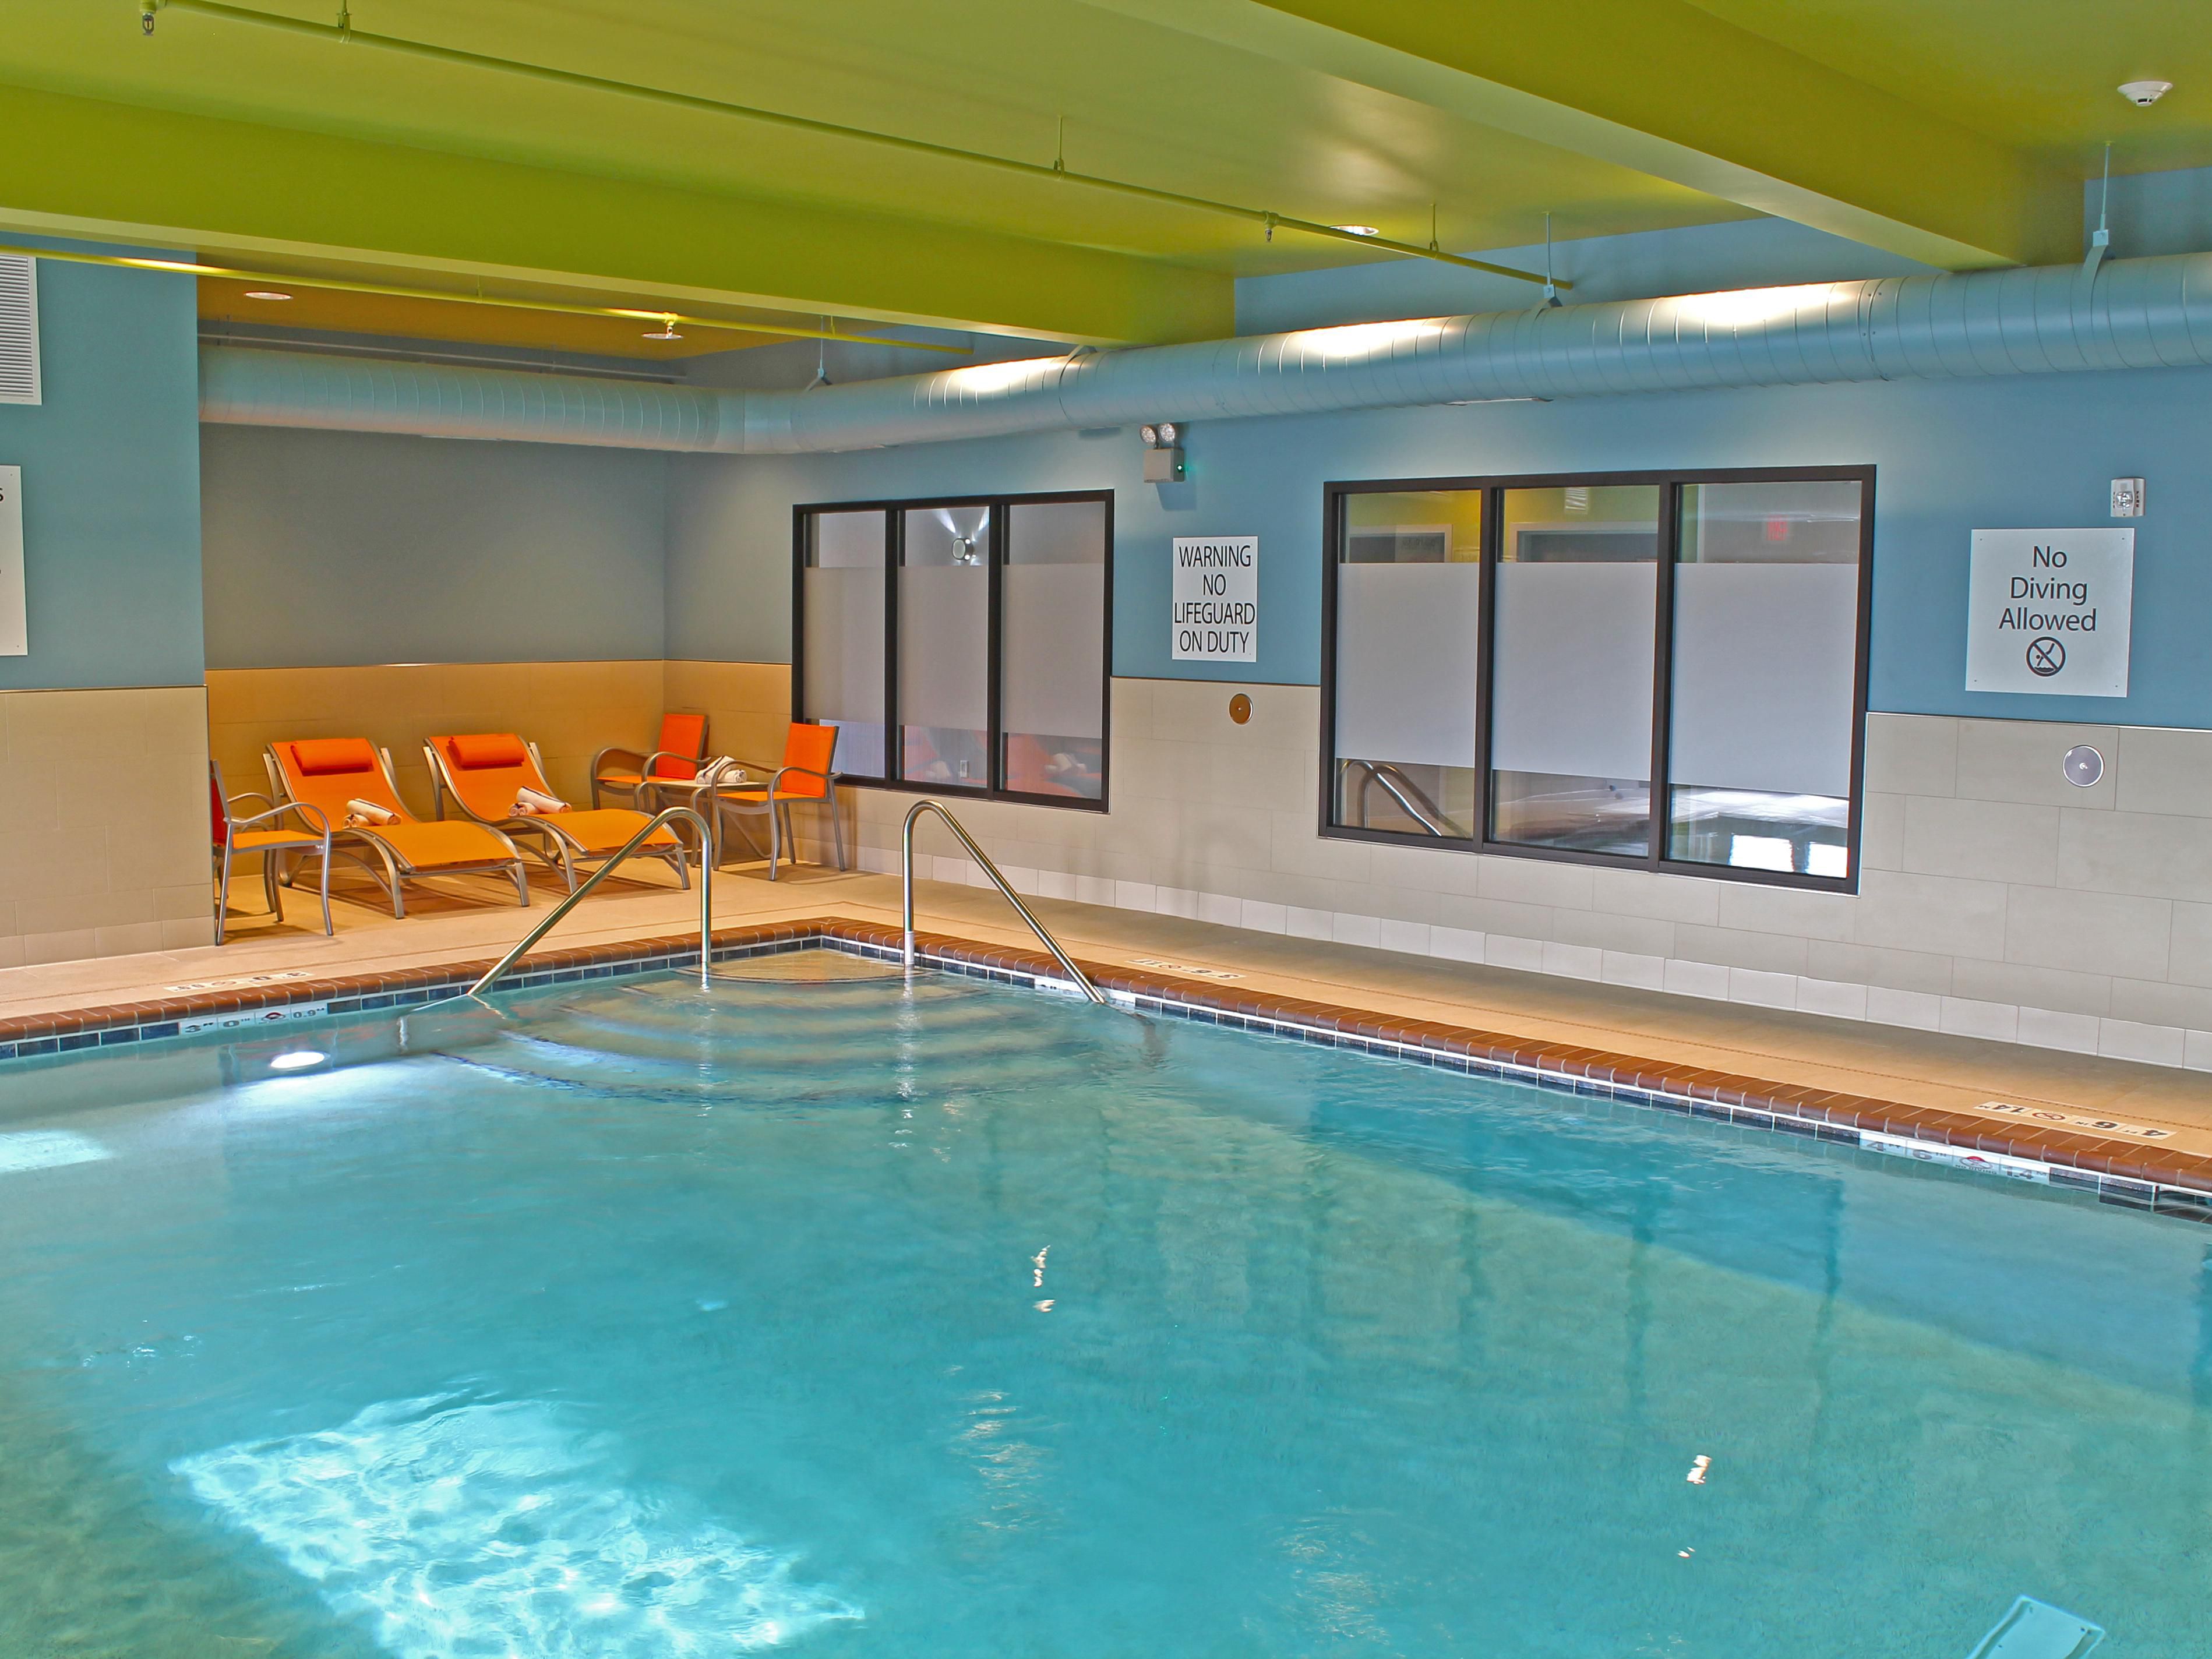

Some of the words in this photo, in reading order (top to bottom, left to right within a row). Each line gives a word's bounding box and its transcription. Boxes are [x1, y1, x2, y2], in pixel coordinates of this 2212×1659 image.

[1179, 545, 1251, 567] WARNING
[2033, 546, 2068, 568] No
[1203, 574, 1226, 596] NO
[2010, 577, 2087, 606] Diving
[1174, 602, 1255, 624] LIFEGUARD
[1998, 608, 2097, 631] Allowed
[1180, 630, 1202, 652] ON
[1207, 631, 1249, 653] DUTY
[185, 1025, 201, 1033] 3
[293, 1009, 316, 1018] 0.9
[1867, 1142, 1886, 1152] 4
[1913, 1149, 1932, 1160] 6
[2003, 1166, 2034, 1180] 1.4
[1968, 1166, 1998, 1176] DIVING
